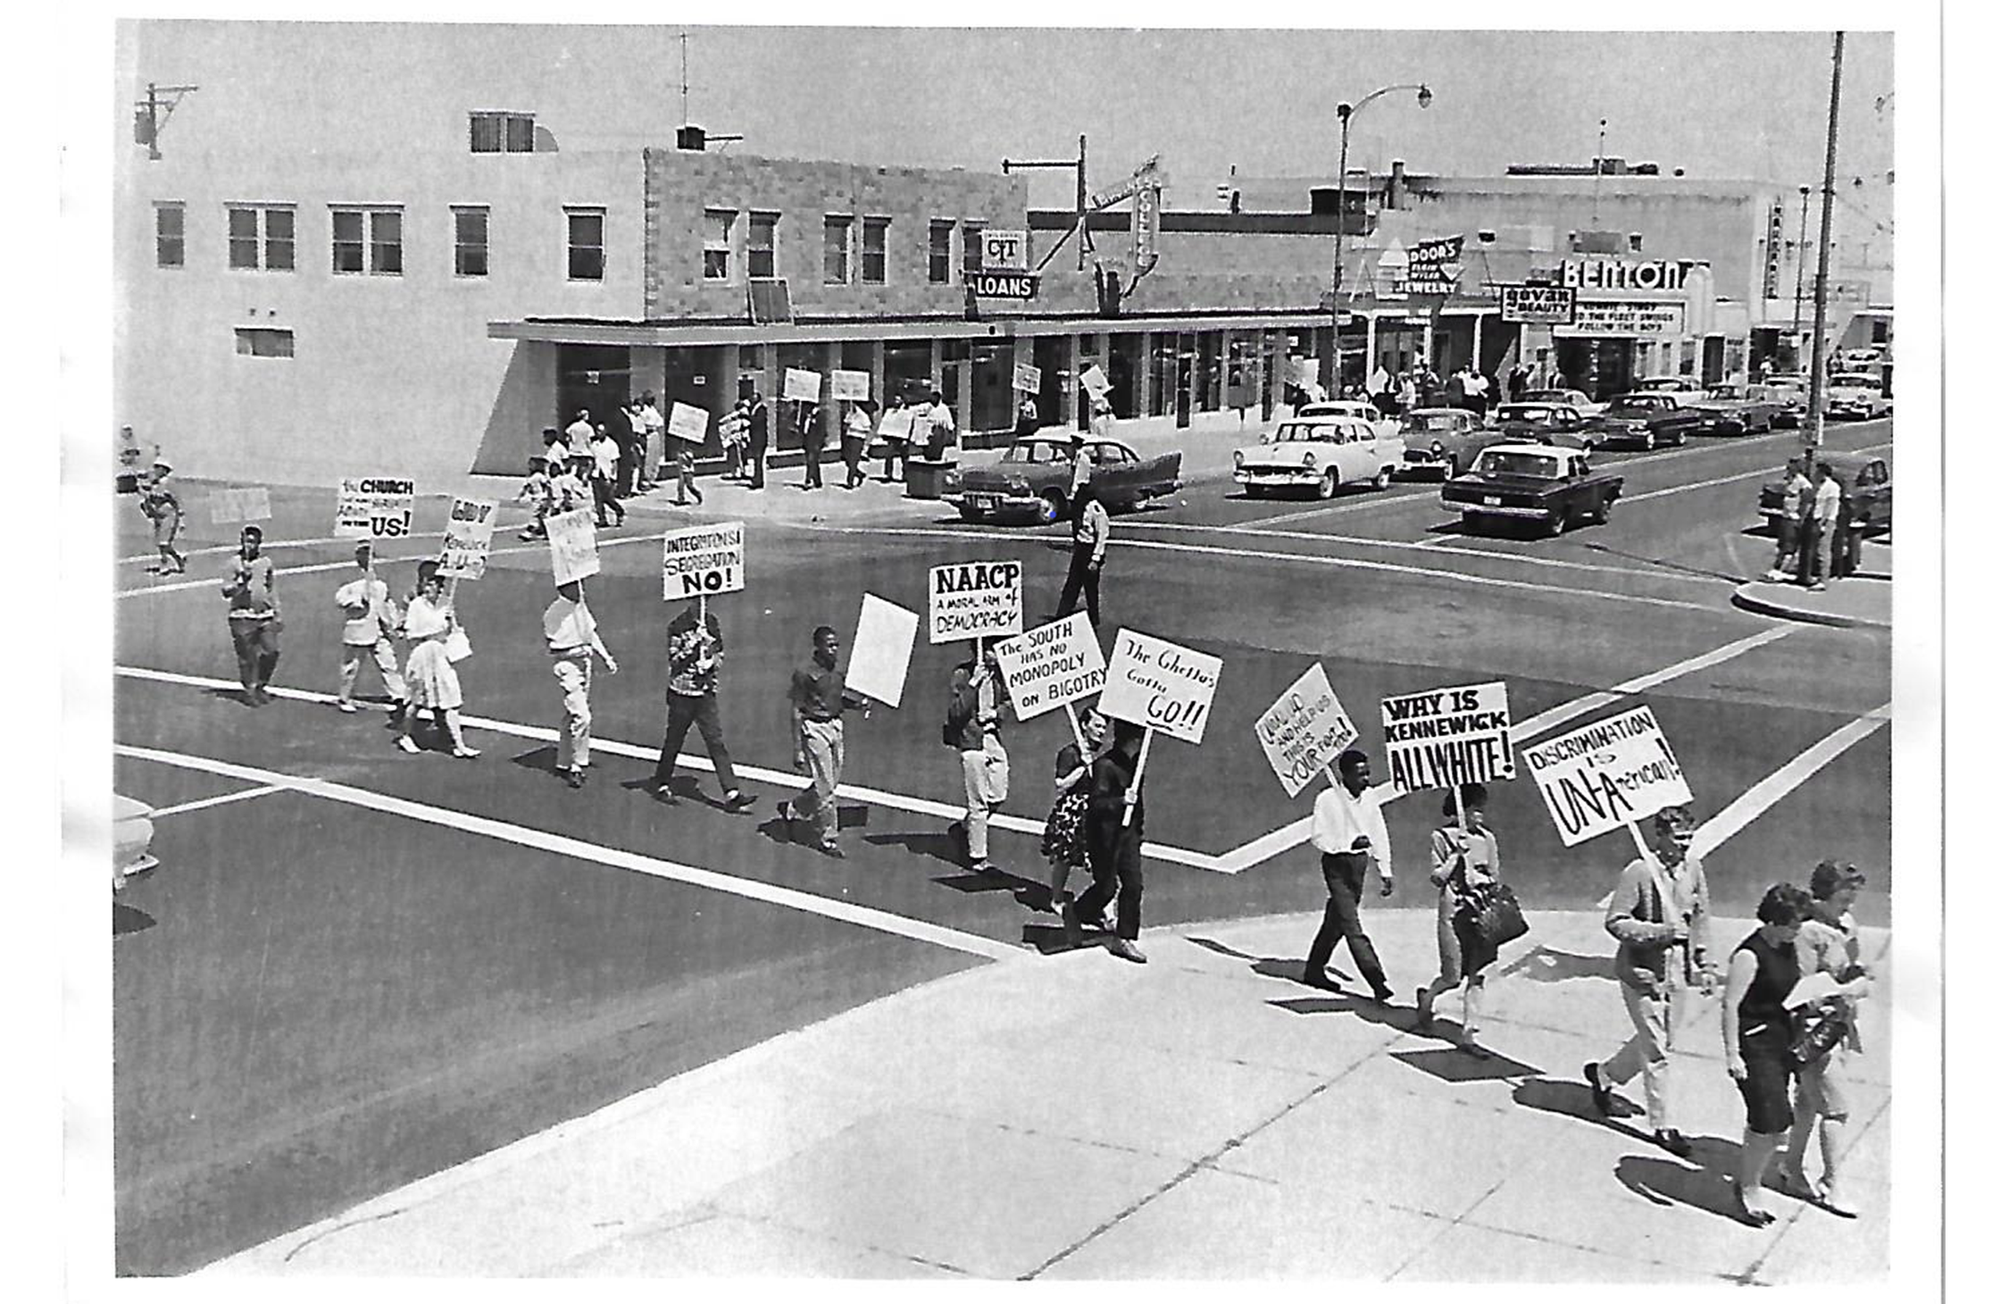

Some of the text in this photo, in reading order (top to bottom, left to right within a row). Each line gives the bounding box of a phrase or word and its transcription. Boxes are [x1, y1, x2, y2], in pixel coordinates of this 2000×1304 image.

[1410, 241, 1456, 263] DOOR'S
[977, 277, 1032, 296] LOANS
[1395, 281, 1457, 293] JEWELRY
[1518, 303, 1568, 313] BEAUTY
[361, 480, 413, 494] CHURCH
[370, 510, 411, 537] US!
[682, 567, 731, 594] NO!
[936, 564, 1019, 594] NAACP
[937, 587, 1018, 609] A MORAL ARM of
[937, 610, 1018, 633] DEMOCRACY
[1000, 621, 1073, 656] The SOUTH
[1021, 643, 1067, 664] HAS NO
[1010, 652, 1084, 688] MONOPOLY
[1048, 667, 1108, 700] BIGOTRY
[1148, 695, 1205, 731] GO!!
[1383, 690, 1479, 720] WHY IS
[1278, 727, 1295, 746] AND
[1293, 707, 1317, 734] HELP
[1385, 711, 1508, 743] KENNEWICK
[1529, 711, 1655, 770] DISCRIMINATION
[1283, 748, 1322, 786] YOUR
[1586, 752, 1617, 768] IS
